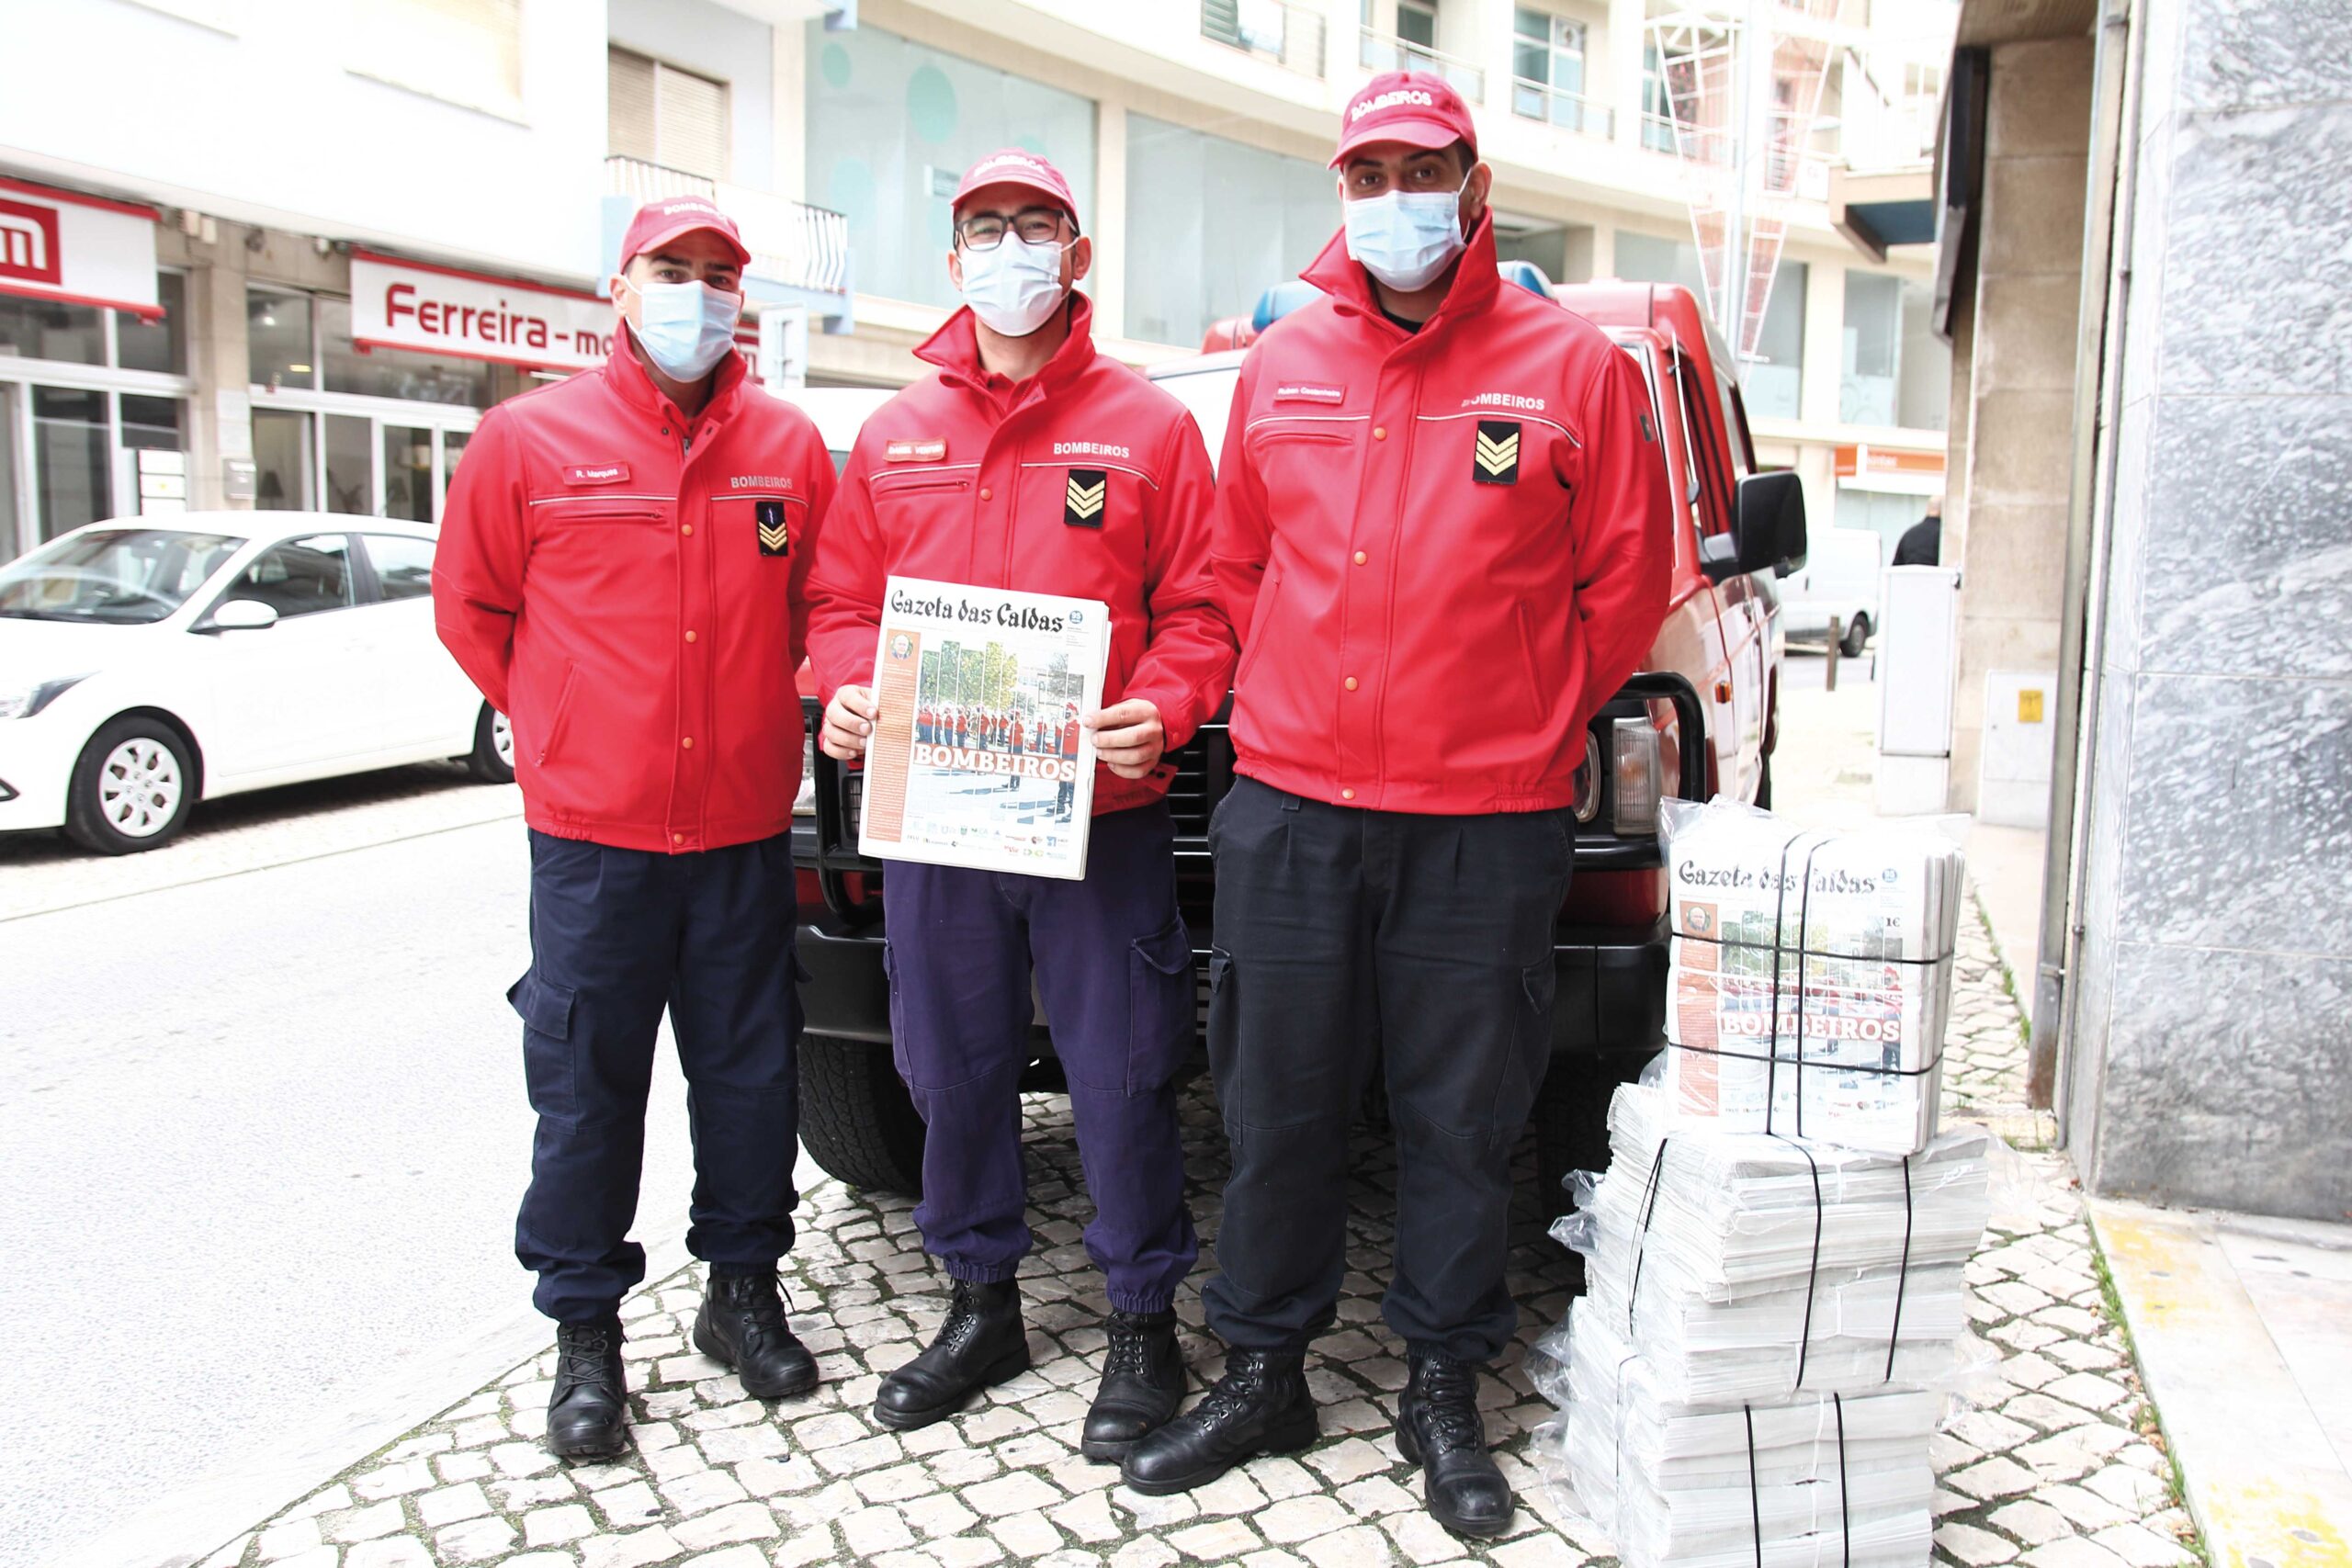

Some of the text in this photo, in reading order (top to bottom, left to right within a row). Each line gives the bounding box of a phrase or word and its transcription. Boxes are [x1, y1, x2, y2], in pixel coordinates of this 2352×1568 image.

[1351, 90, 1432, 122] BOMBEIROS
[1053, 441, 1130, 458] BOMBEIROS
[729, 475, 794, 490] BOMBEIROS
[891, 590, 1065, 633] Gazeta das Caldas
[914, 743, 1077, 782] BOMBEIROS
[1723, 1012, 1901, 1042] BOMBEIROS
